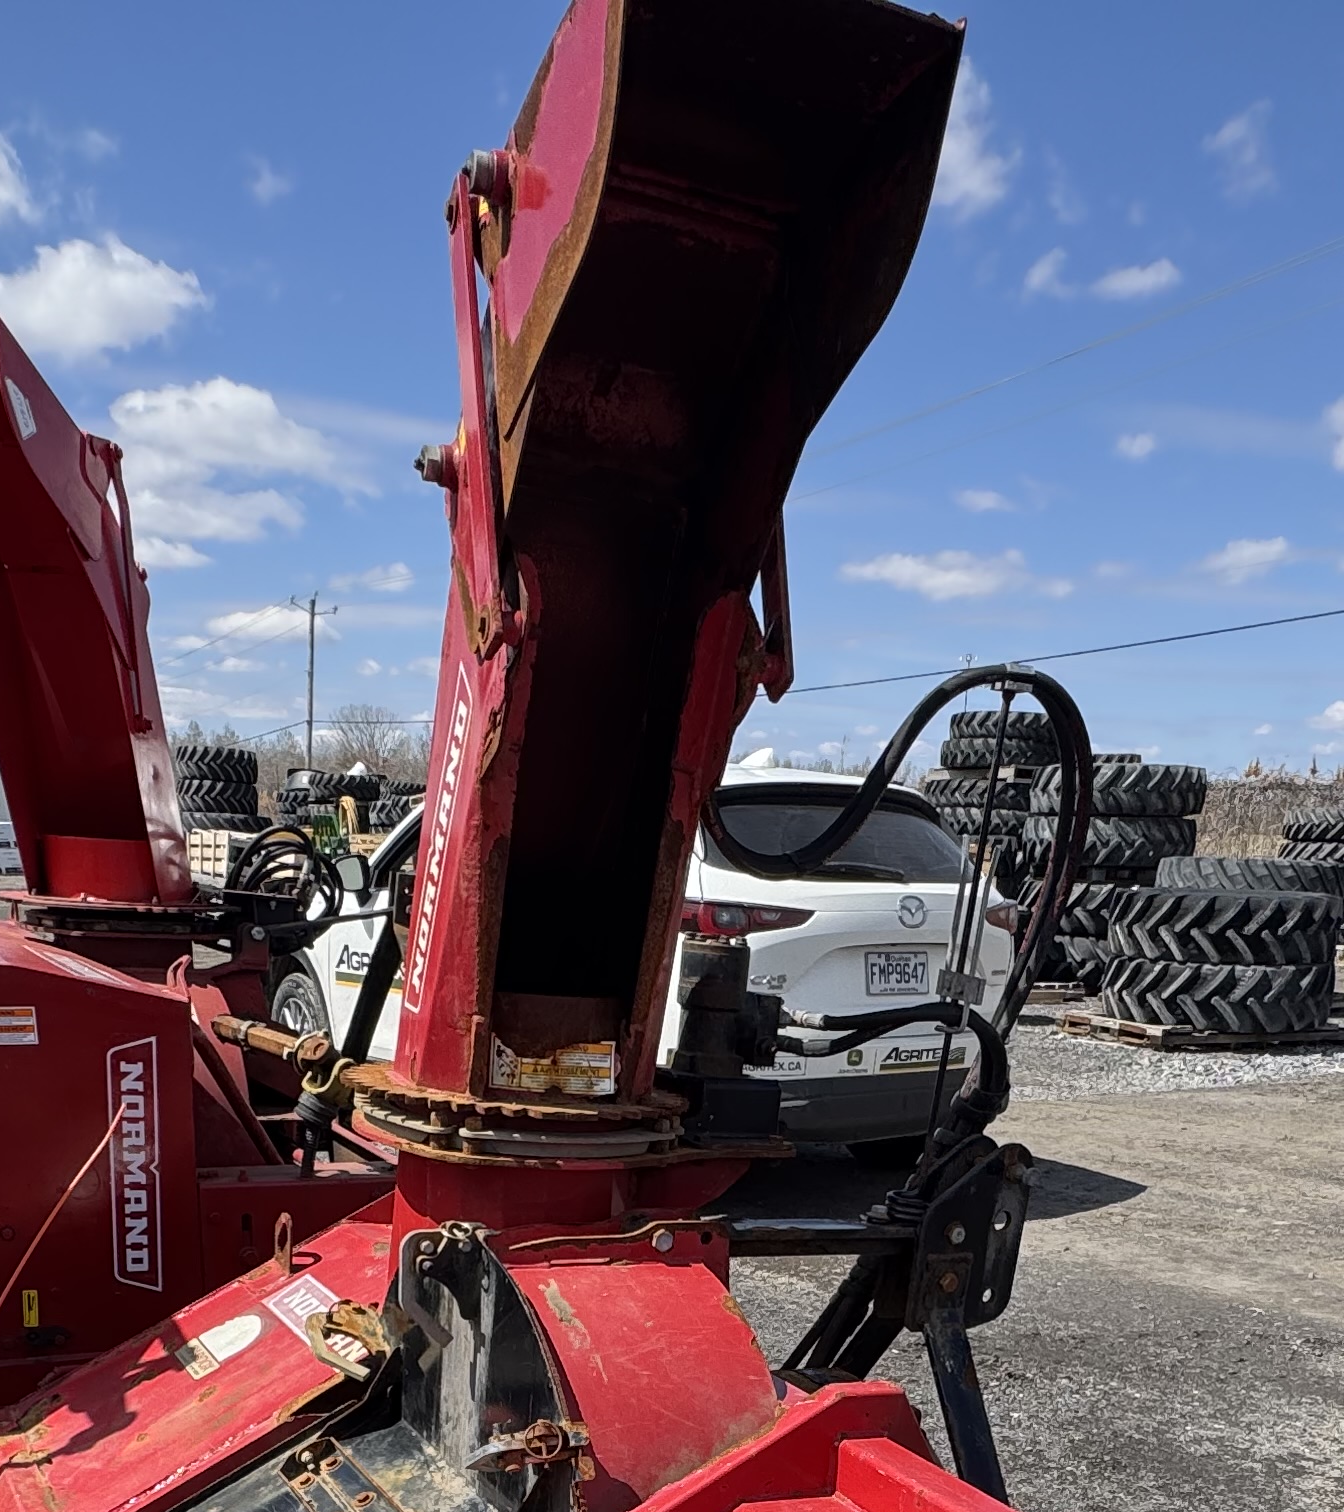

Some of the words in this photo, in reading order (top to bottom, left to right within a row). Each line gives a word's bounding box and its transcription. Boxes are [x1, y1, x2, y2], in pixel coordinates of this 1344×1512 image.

[411, 699, 468, 994] NORMAND
[869, 962, 926, 985] FMP9647
[881, 1046, 944, 1063] AGRITE
[119, 1061, 150, 1273] NORMAND
